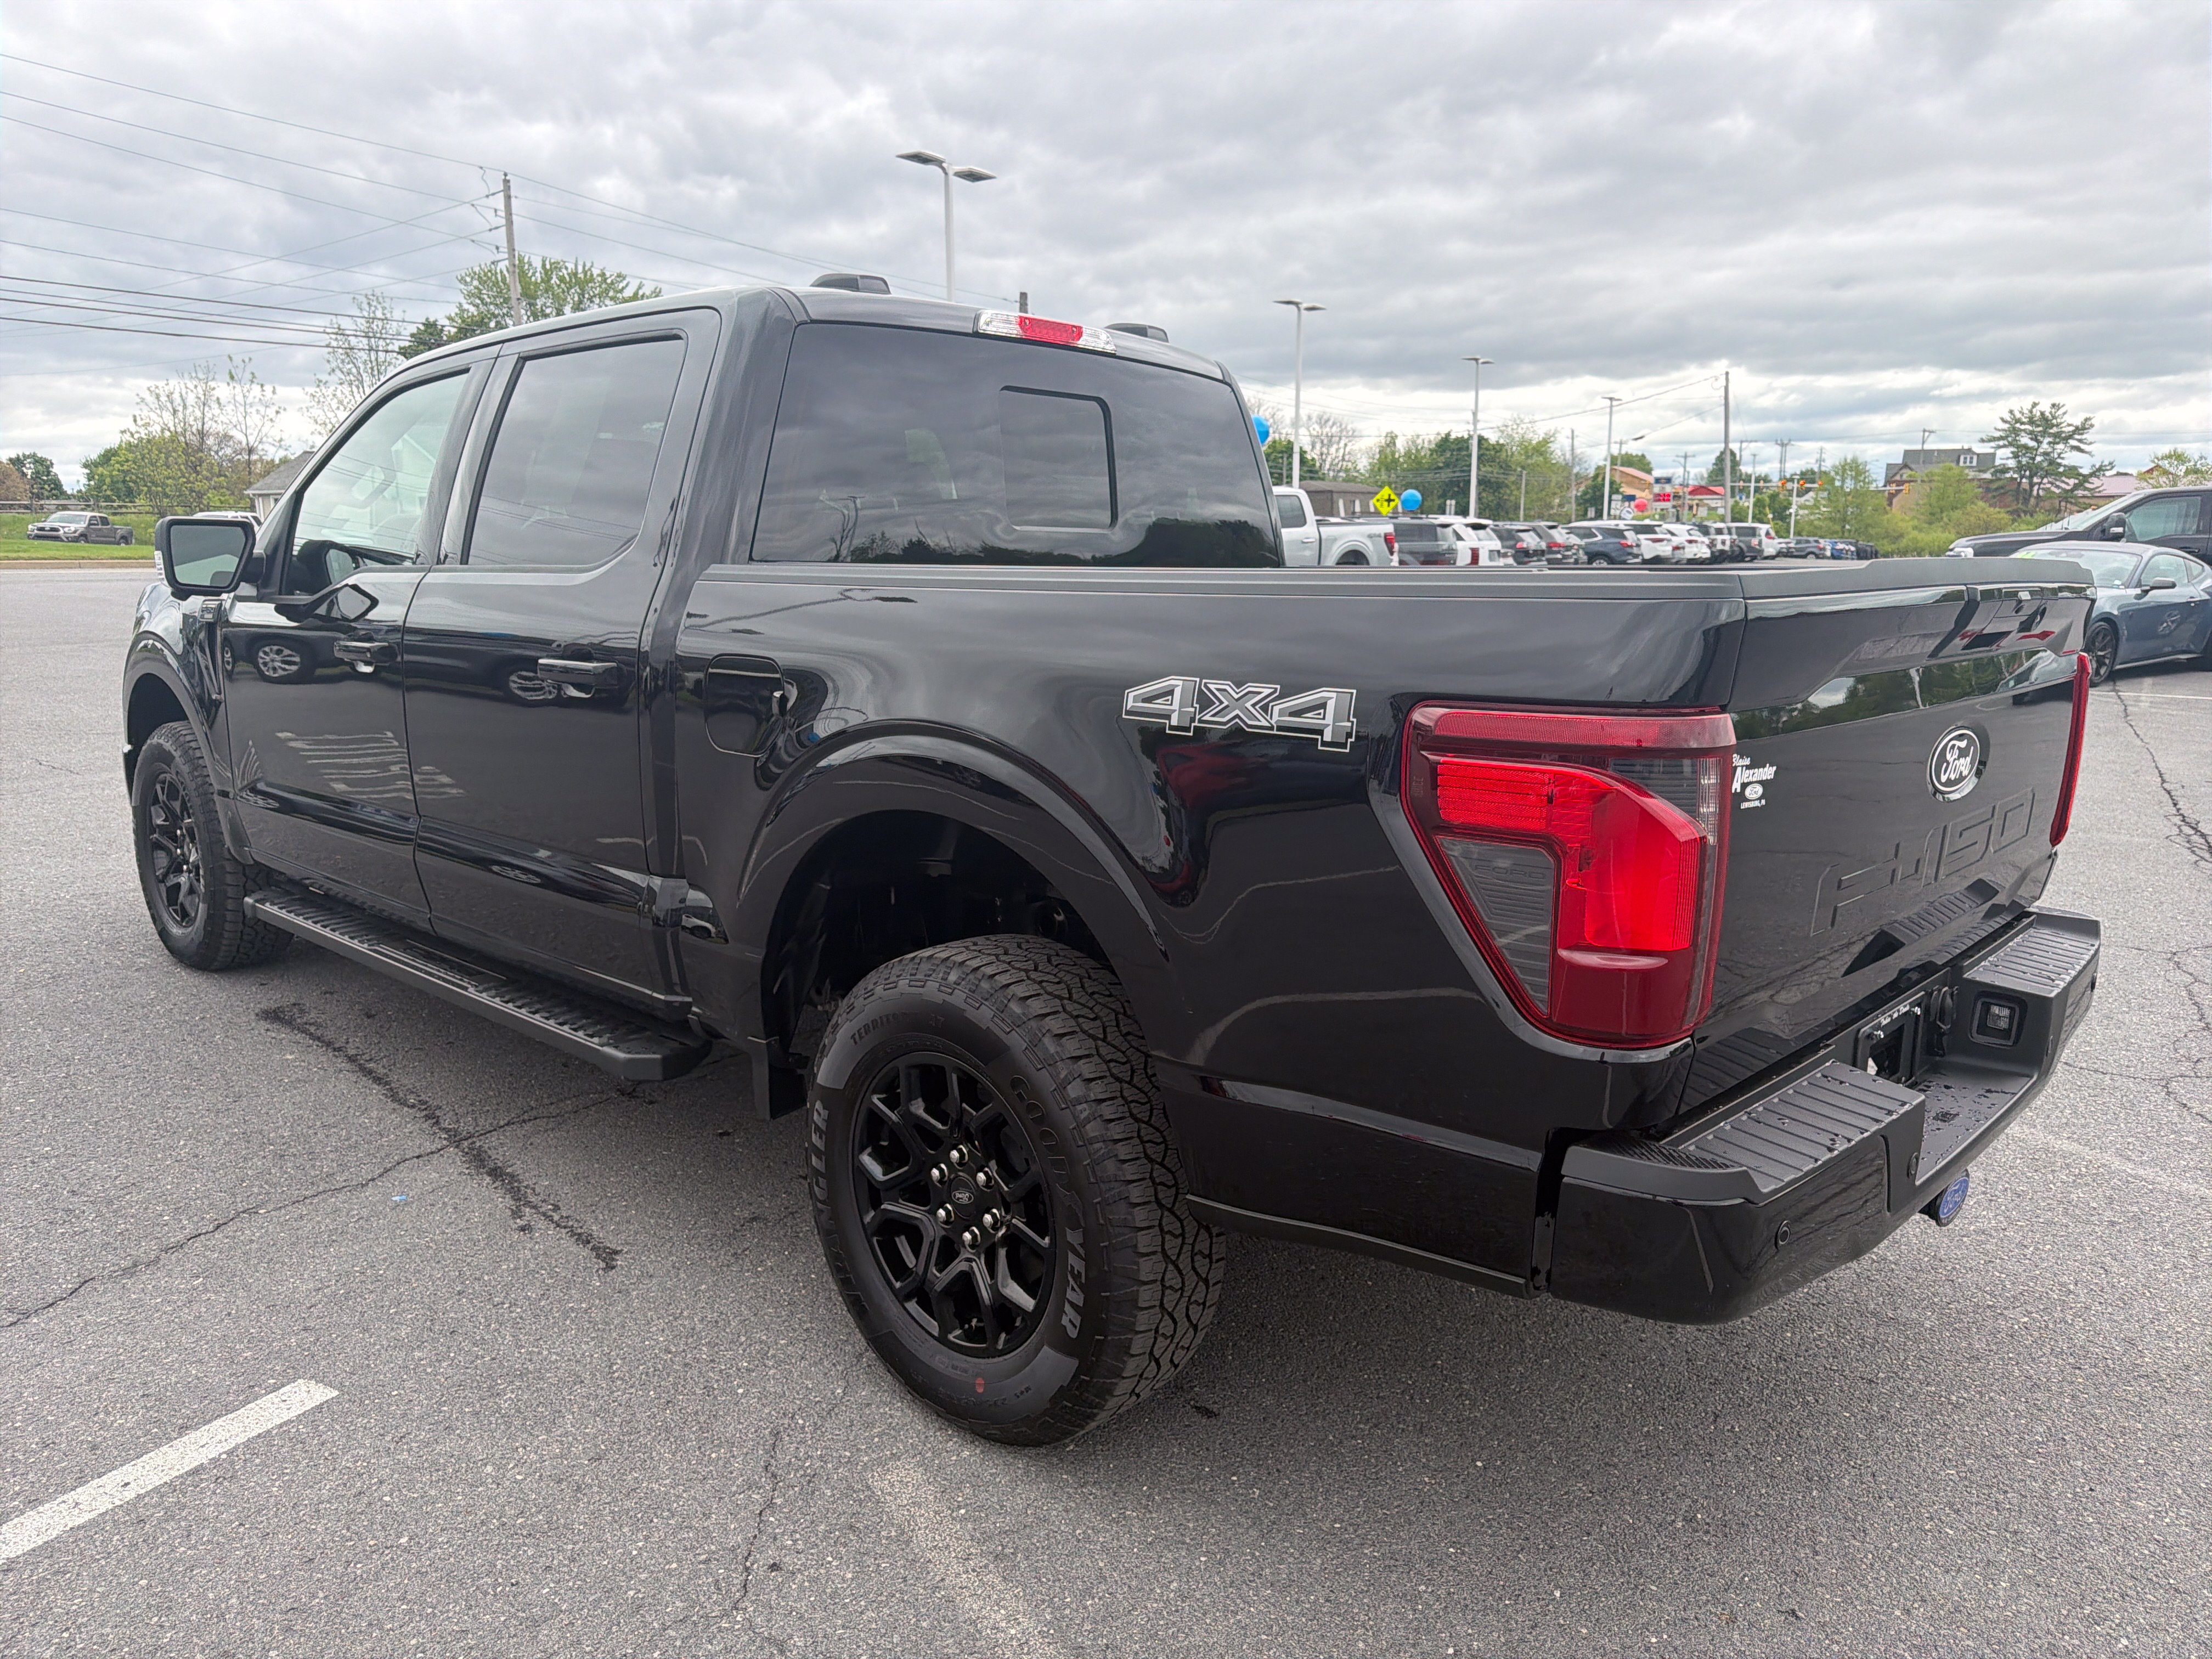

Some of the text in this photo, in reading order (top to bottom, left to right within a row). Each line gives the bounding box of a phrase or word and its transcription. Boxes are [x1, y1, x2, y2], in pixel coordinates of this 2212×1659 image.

[1732, 753, 1751, 766] Blaise
[1941, 739, 1974, 783] Ford
[1732, 763, 1777, 793] Alexander
[1475, 864, 1546, 879] FORD
[1009, 1075, 1085, 1339] GOODYEAR
